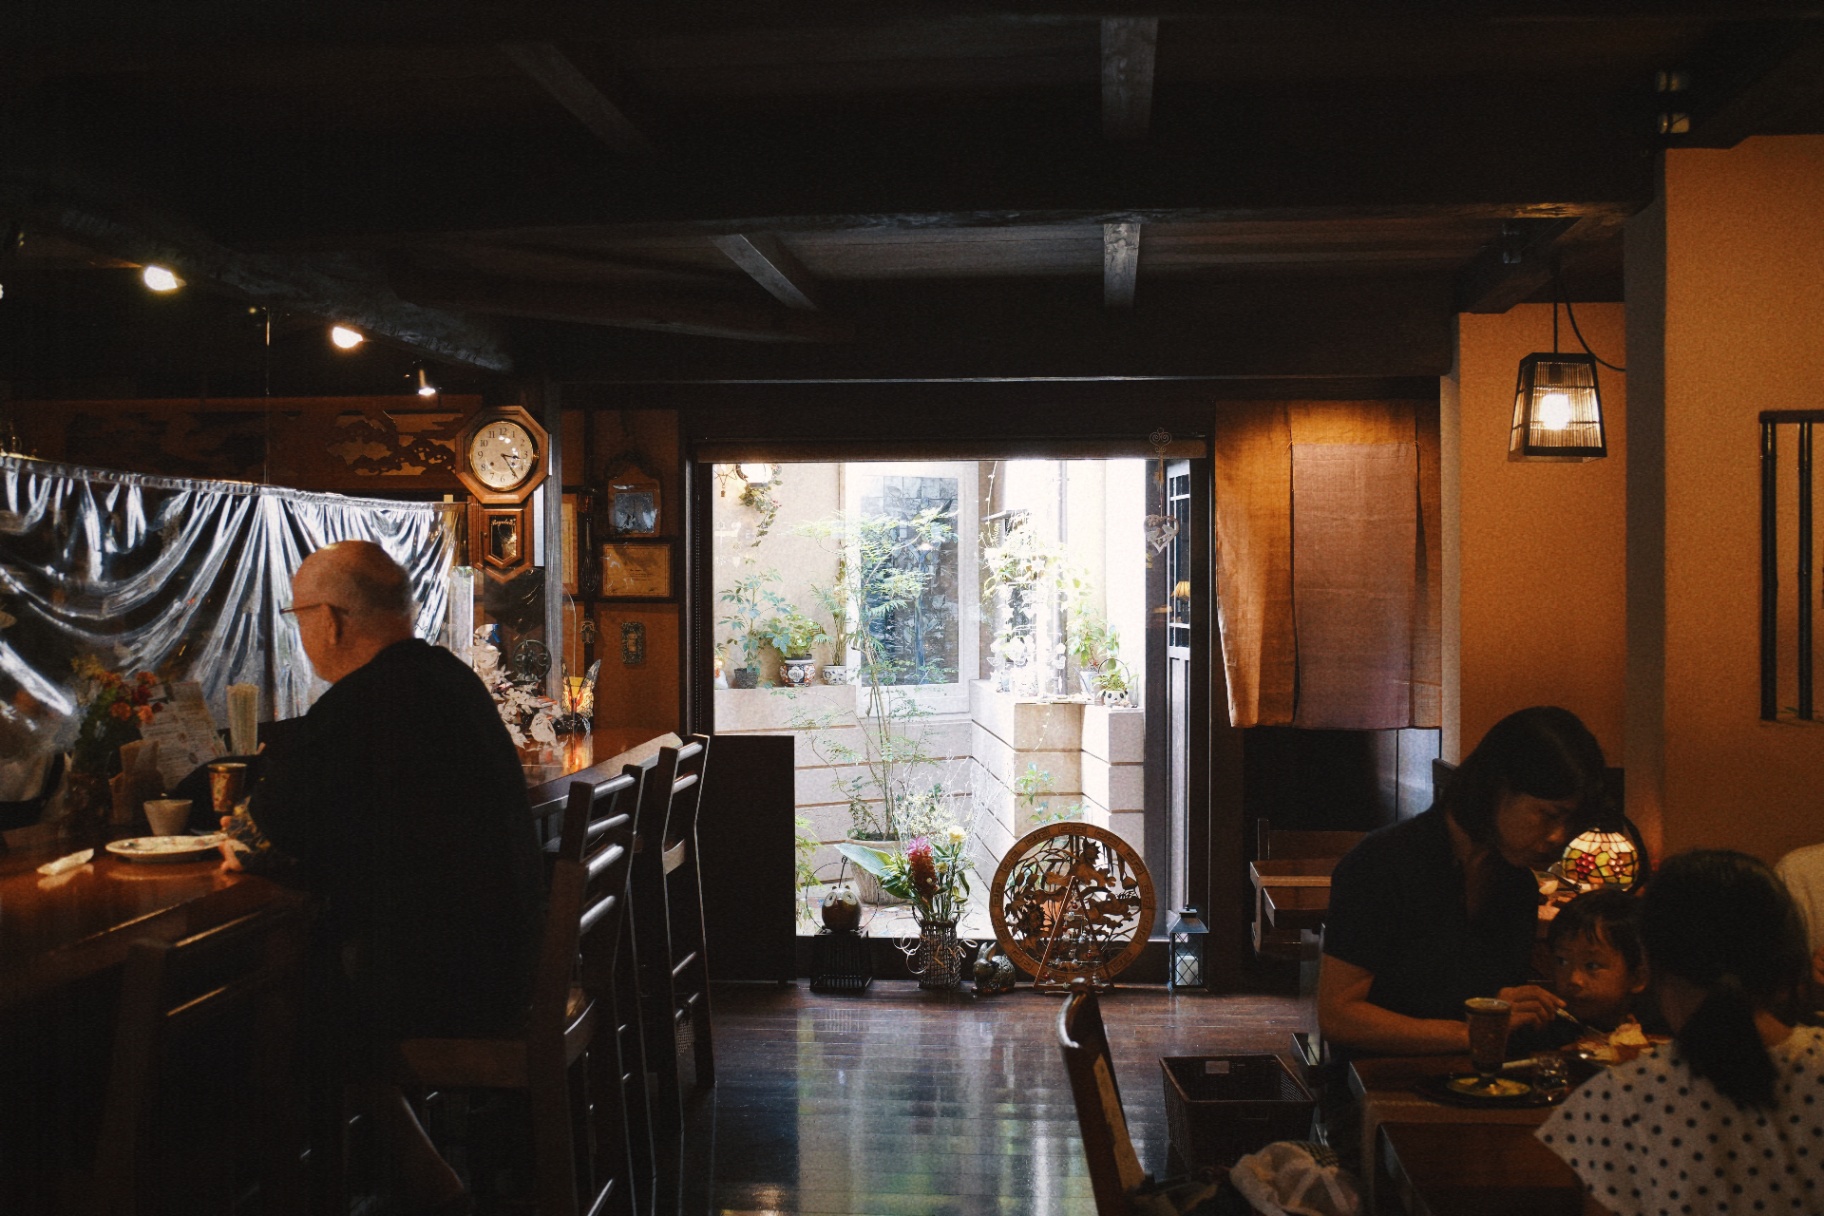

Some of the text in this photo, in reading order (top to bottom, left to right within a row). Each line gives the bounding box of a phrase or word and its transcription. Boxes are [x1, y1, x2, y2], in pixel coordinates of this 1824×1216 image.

[488, 430, 495, 438] 11
[499, 428, 507, 436] 12
[511, 430, 515, 438] 1
[520, 439, 525, 447] 2
[478, 450, 484, 459] 9
[523, 451, 528, 459] 3
[481, 463, 486, 471] 8
[490, 472, 495, 480] 7
